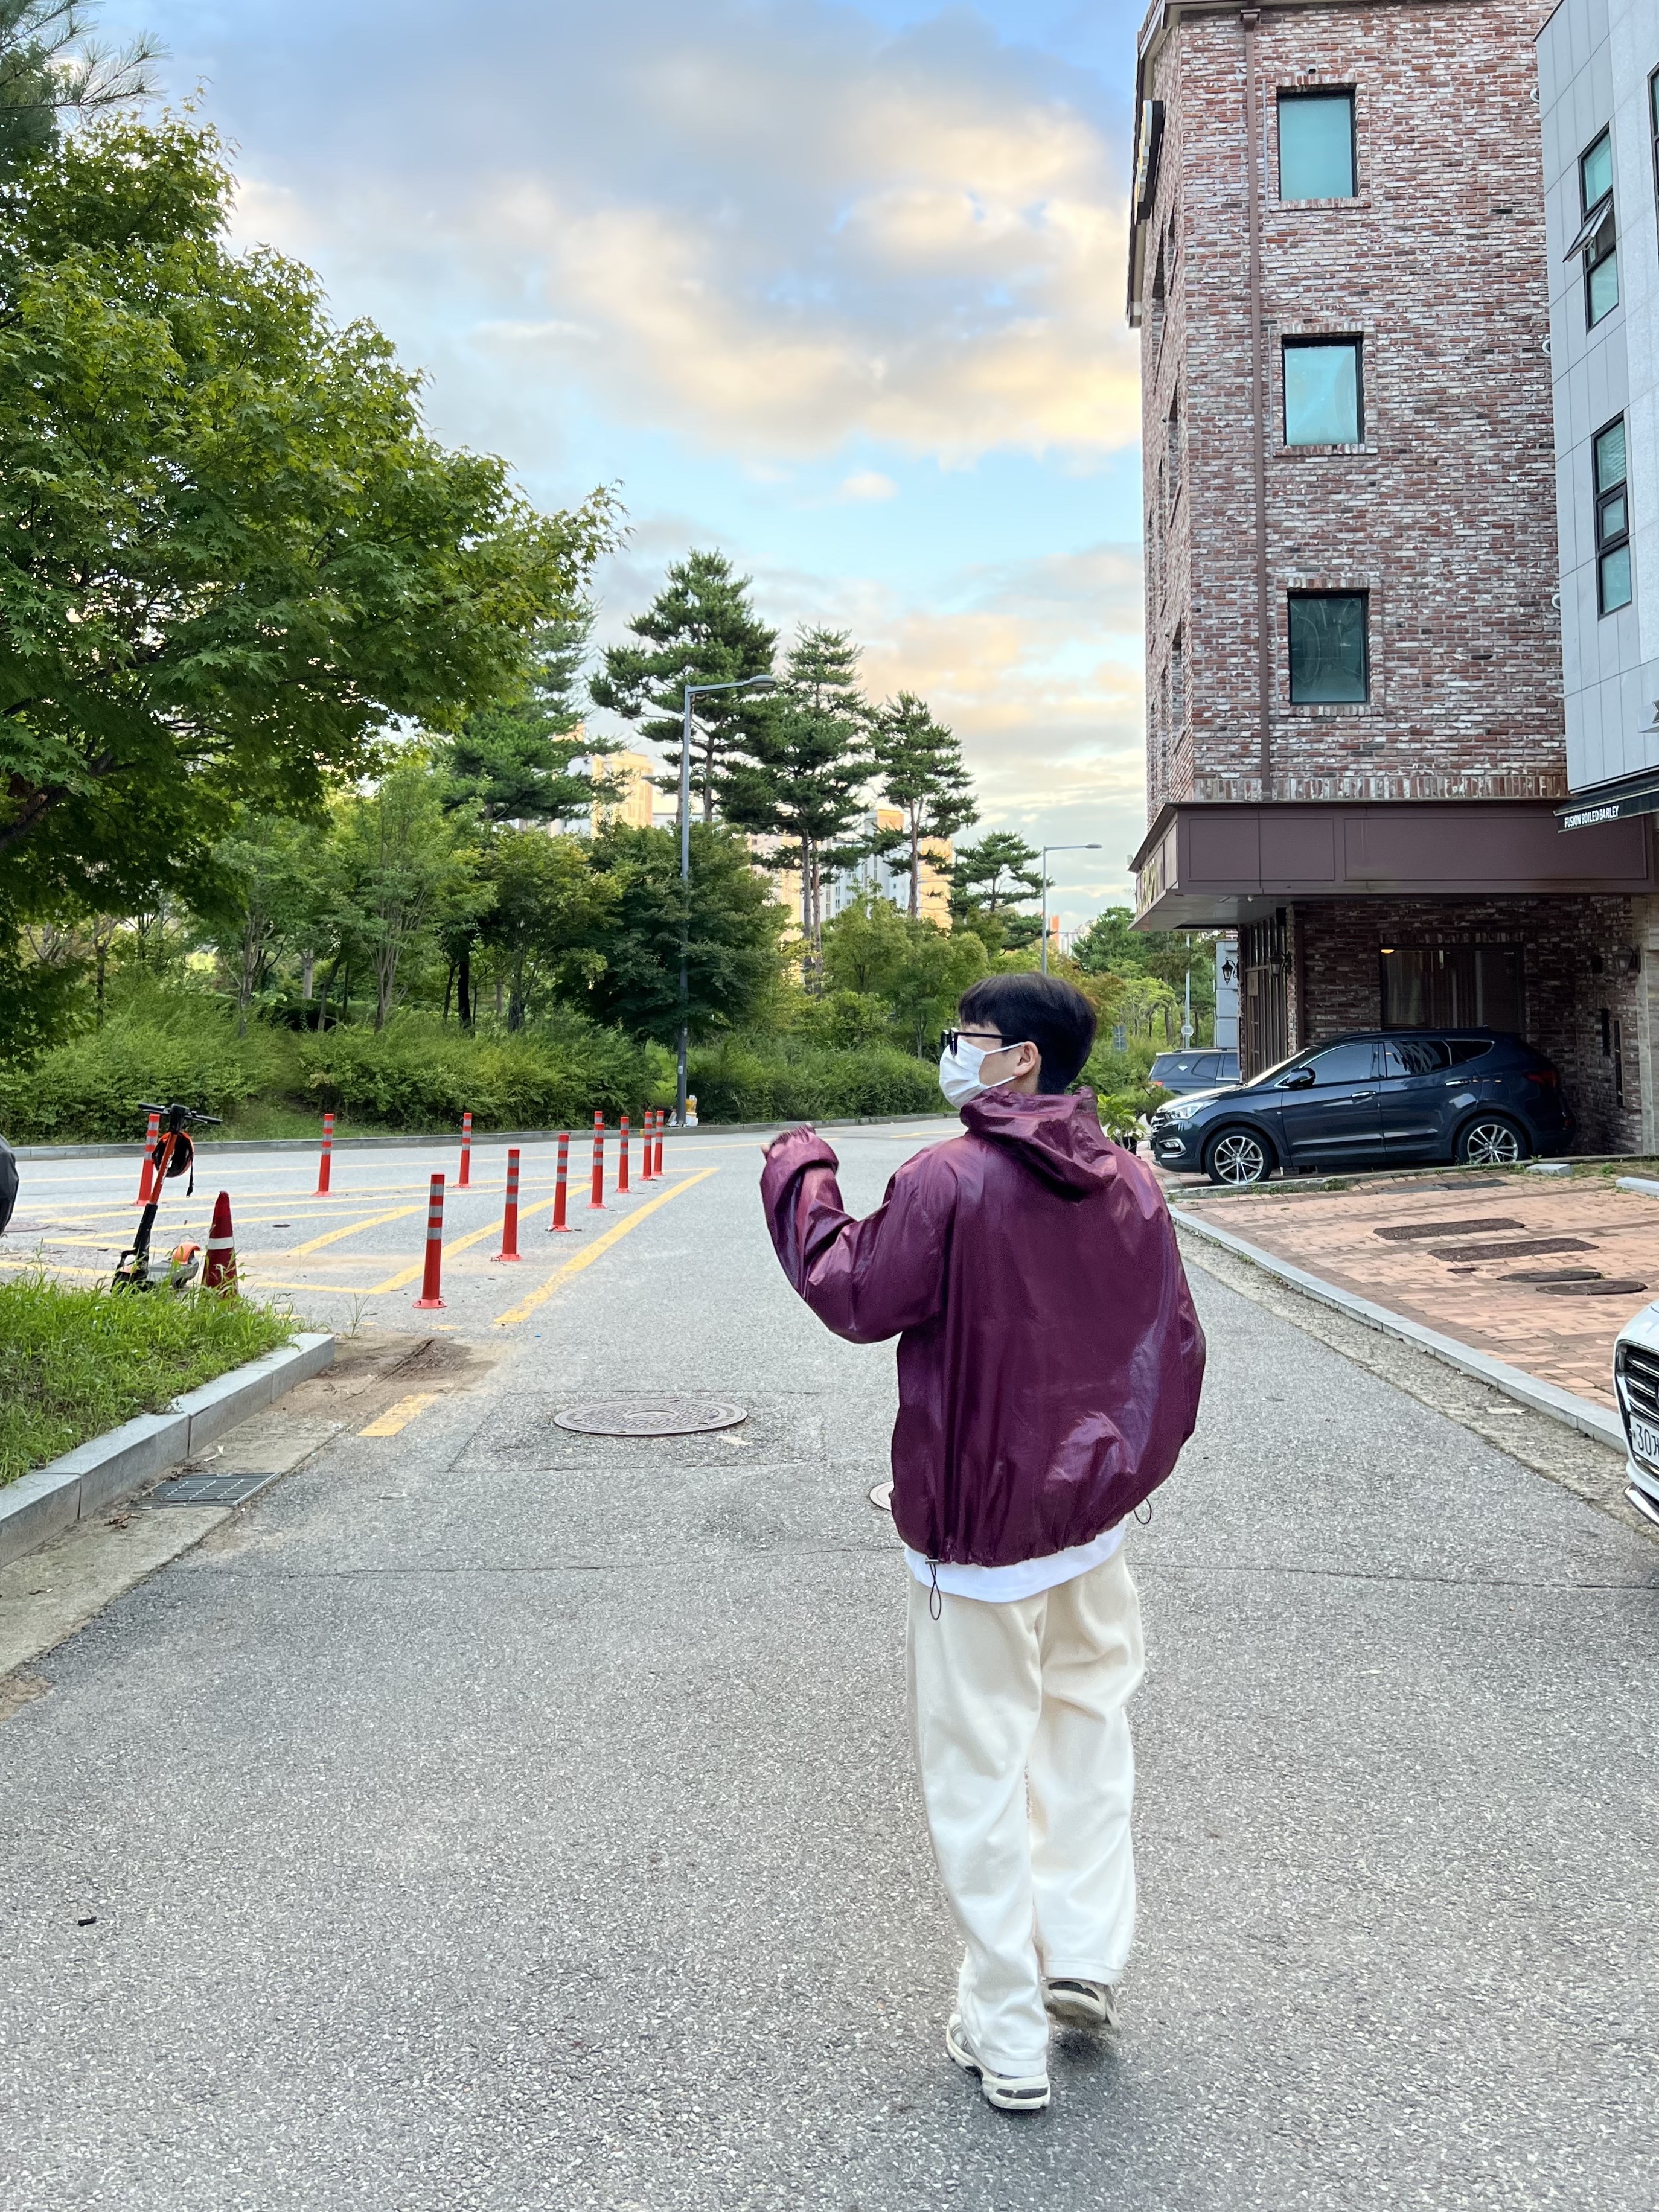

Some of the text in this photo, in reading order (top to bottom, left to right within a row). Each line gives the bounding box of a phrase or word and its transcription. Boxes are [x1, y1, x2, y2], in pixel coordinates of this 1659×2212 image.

[1564, 805, 1619, 828] FUSION BOILED BARLEY
